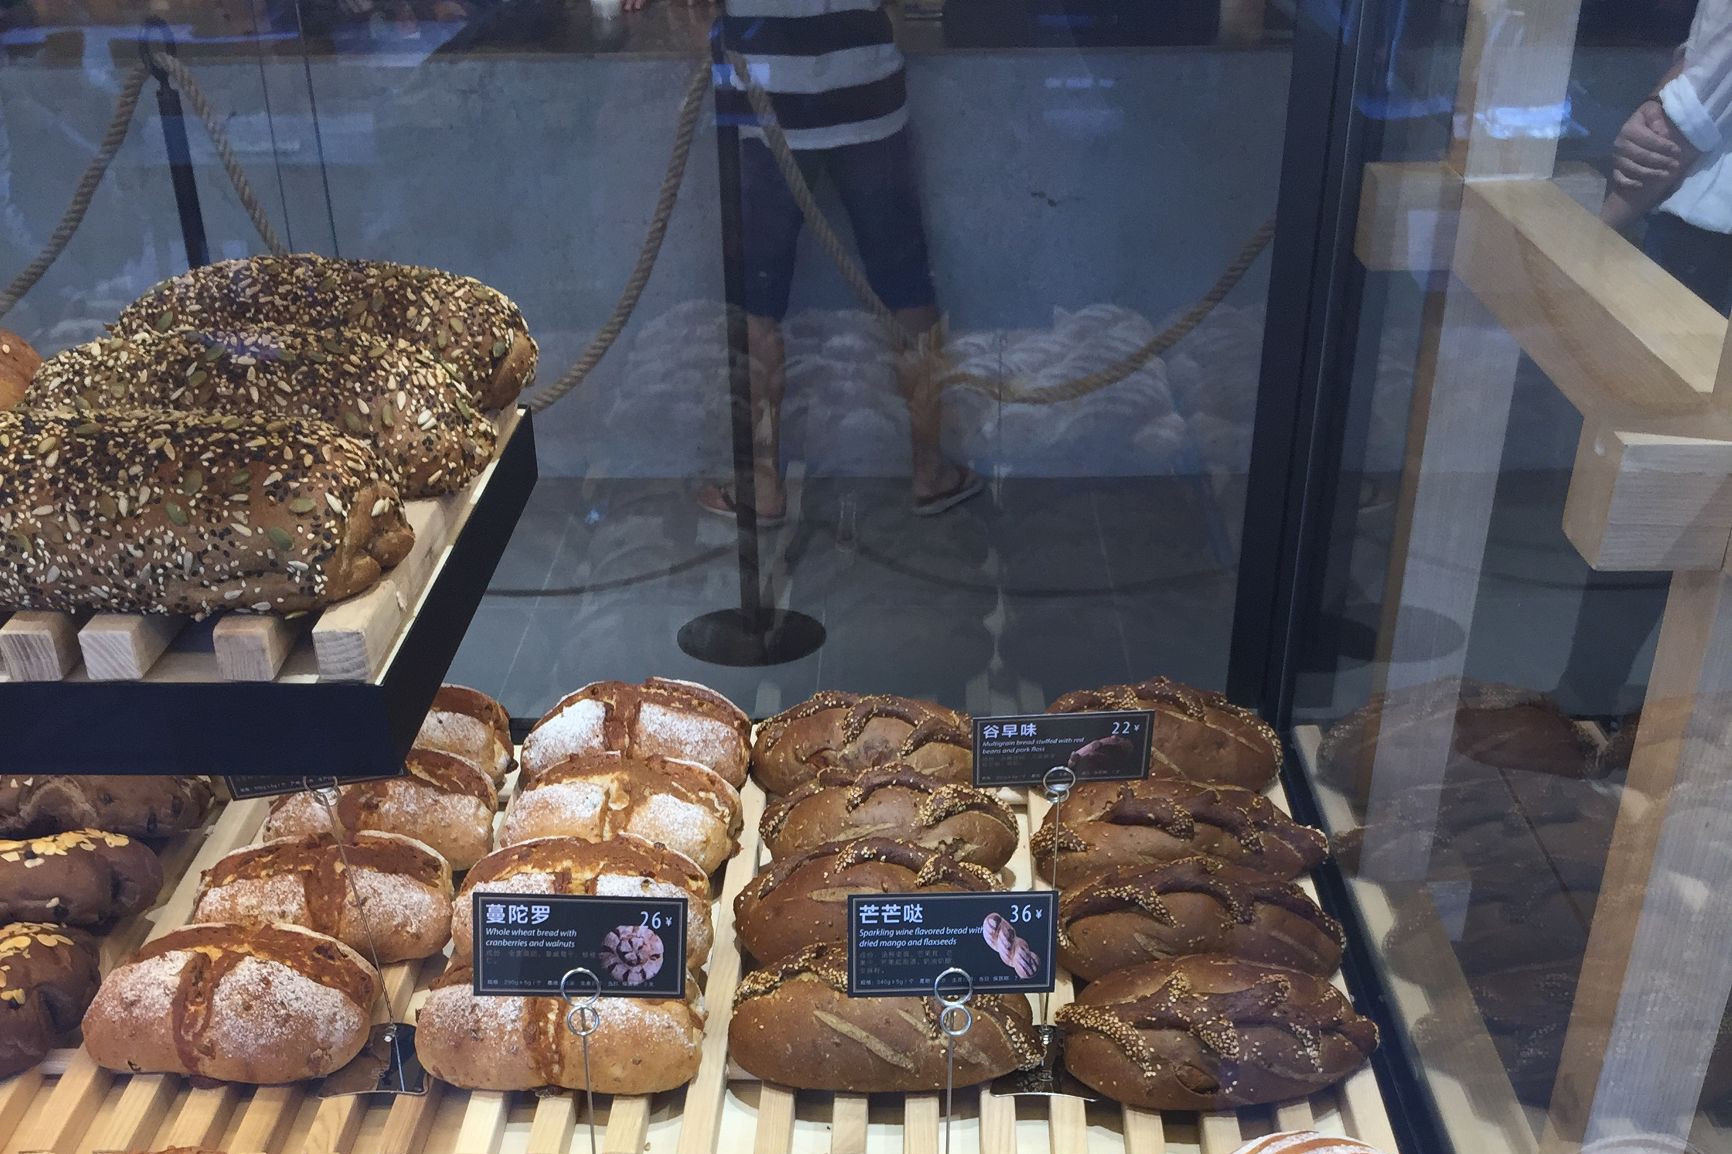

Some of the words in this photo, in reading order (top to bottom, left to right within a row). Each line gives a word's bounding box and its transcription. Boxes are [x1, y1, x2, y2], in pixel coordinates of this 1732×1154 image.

[983, 722, 1037, 739] 谷早味
[1015, 747, 1030, 755] pork
[485, 903, 551, 925] 蔓陀罗
[859, 903, 924, 924] 芒芒哒
[485, 927, 511, 936] Whole
[511, 928, 536, 937] wheat
[536, 928, 560, 937] bread
[560, 928, 577, 937] with
[859, 927, 894, 938] Sparkling
[895, 928, 914, 936] wine
[914, 927, 946, 936] flavored
[946, 926, 968, 935] bread
[485, 939, 528, 948] cranberries
[529, 939, 545, 948] and
[545, 939, 576, 948] walnuts
[859, 939, 879, 948] dried
[879, 940, 907, 949] mango
[907, 938, 923, 947] and
[923, 937, 957, 947] flaxseeds
